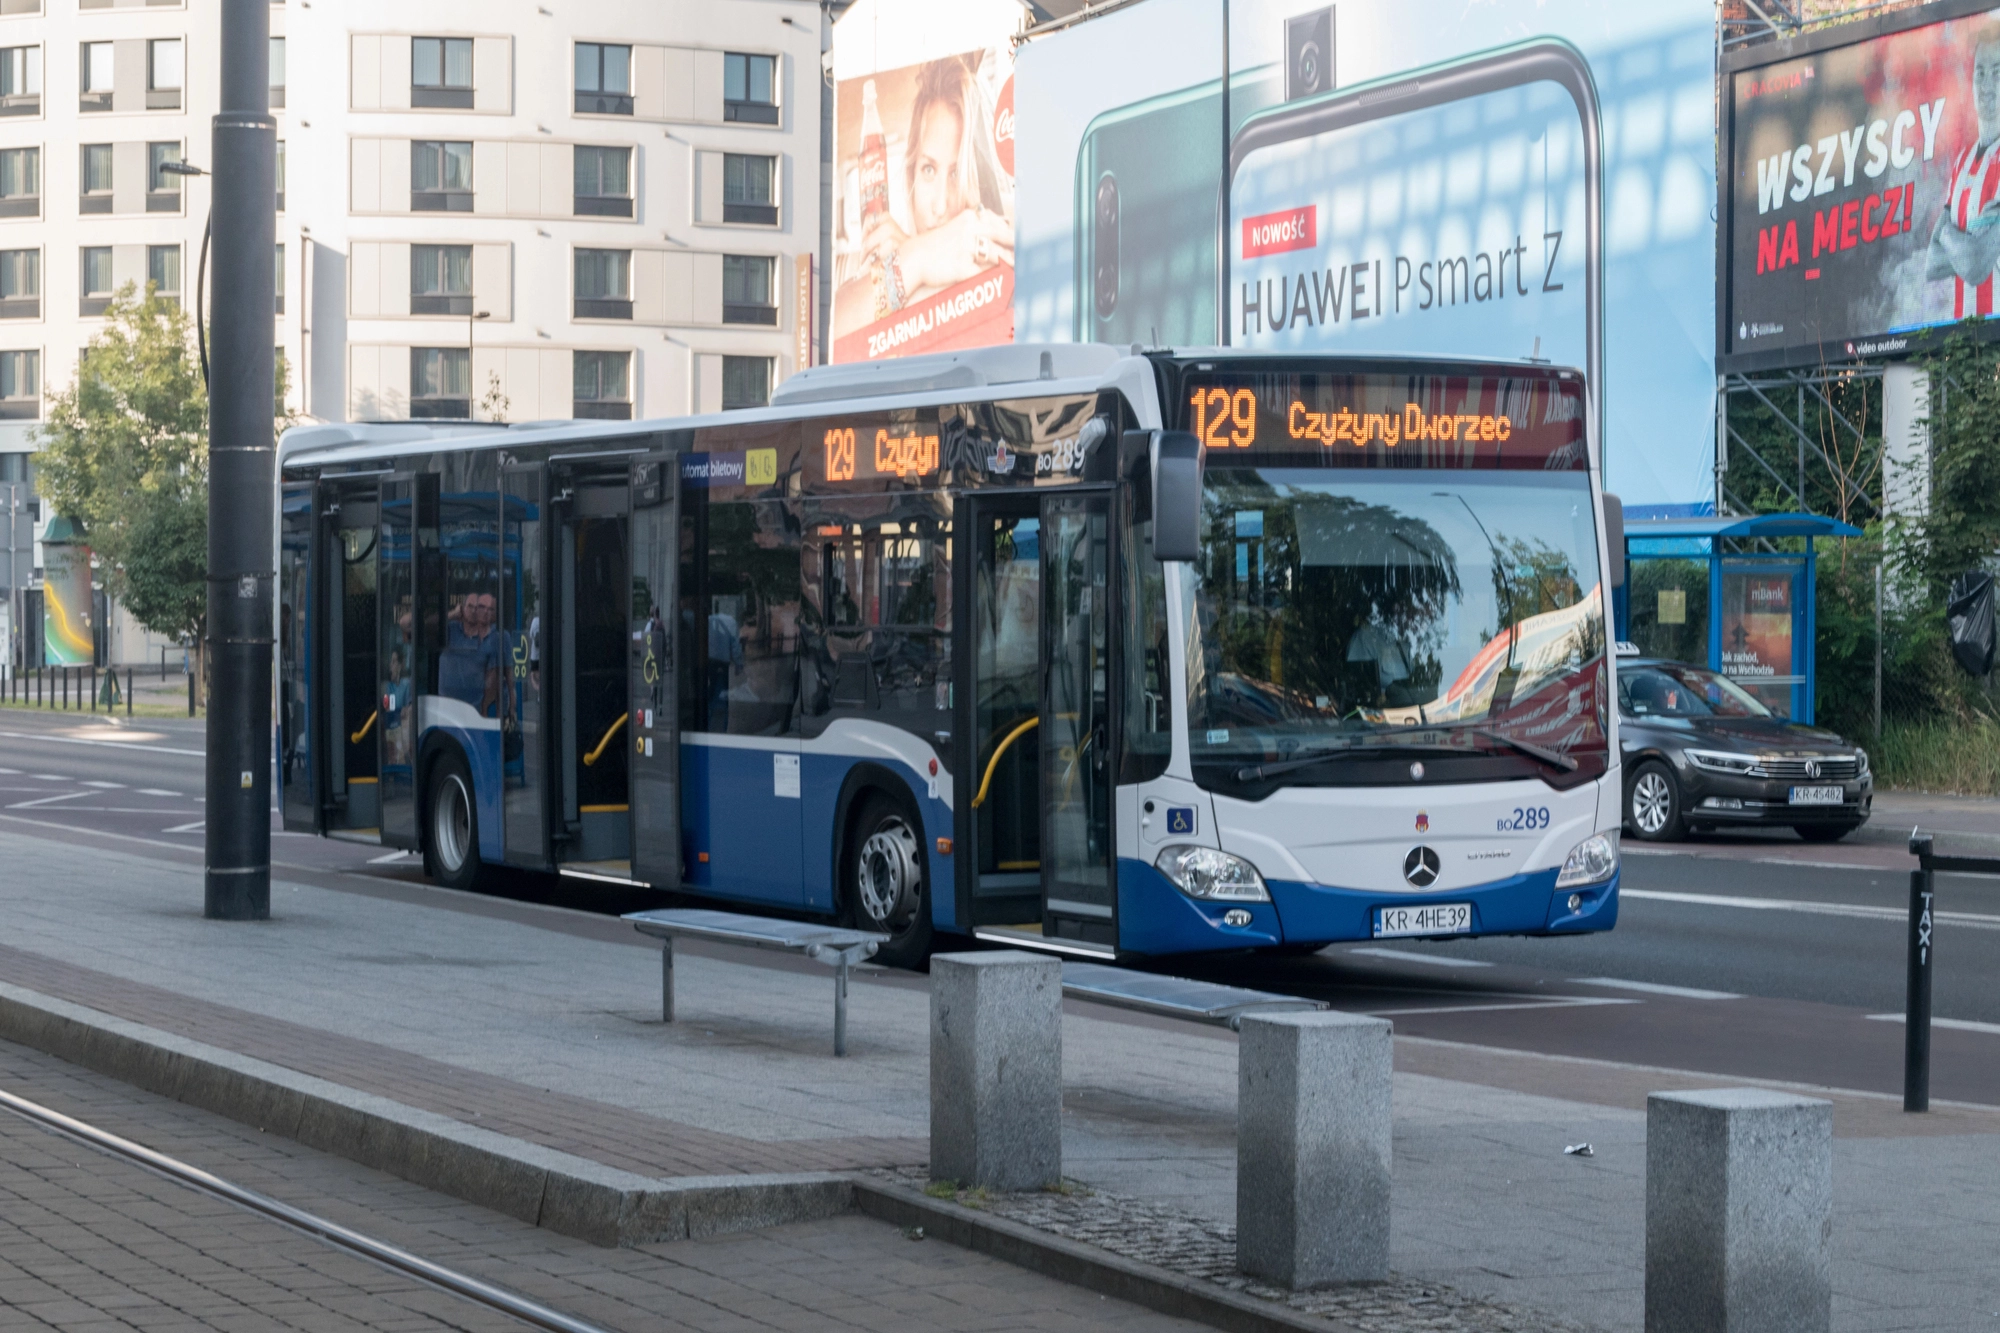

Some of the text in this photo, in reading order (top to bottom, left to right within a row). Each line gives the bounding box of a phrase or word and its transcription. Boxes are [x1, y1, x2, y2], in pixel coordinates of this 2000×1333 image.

[1743, 71, 1802, 99] CRACOVIA
[1757, 97, 1947, 215] WSZYSCY
[1252, 213, 1306, 247] NOWOŚĆ
[1756, 181, 1915, 276] NA MECZ!
[1242, 259, 1381, 335] HUAWEI
[1542, 230, 1564, 293] Z
[868, 273, 1003, 358] ZGARNIAJ NAGRODY
[1857, 338, 1907, 355] video outdoor
[1190, 388, 1256, 447] 129
[682, 460, 744, 480] utomat biletowy
[824, 428, 939, 481] 129 Czyżyn
[1751, 586, 1784, 600] mBank
[1728, 666, 1738, 675] na
[1795, 786, 1809, 801] KR
[1385, 907, 1467, 931] KR 4HE39
[1919, 892, 1934, 966] TAXI
